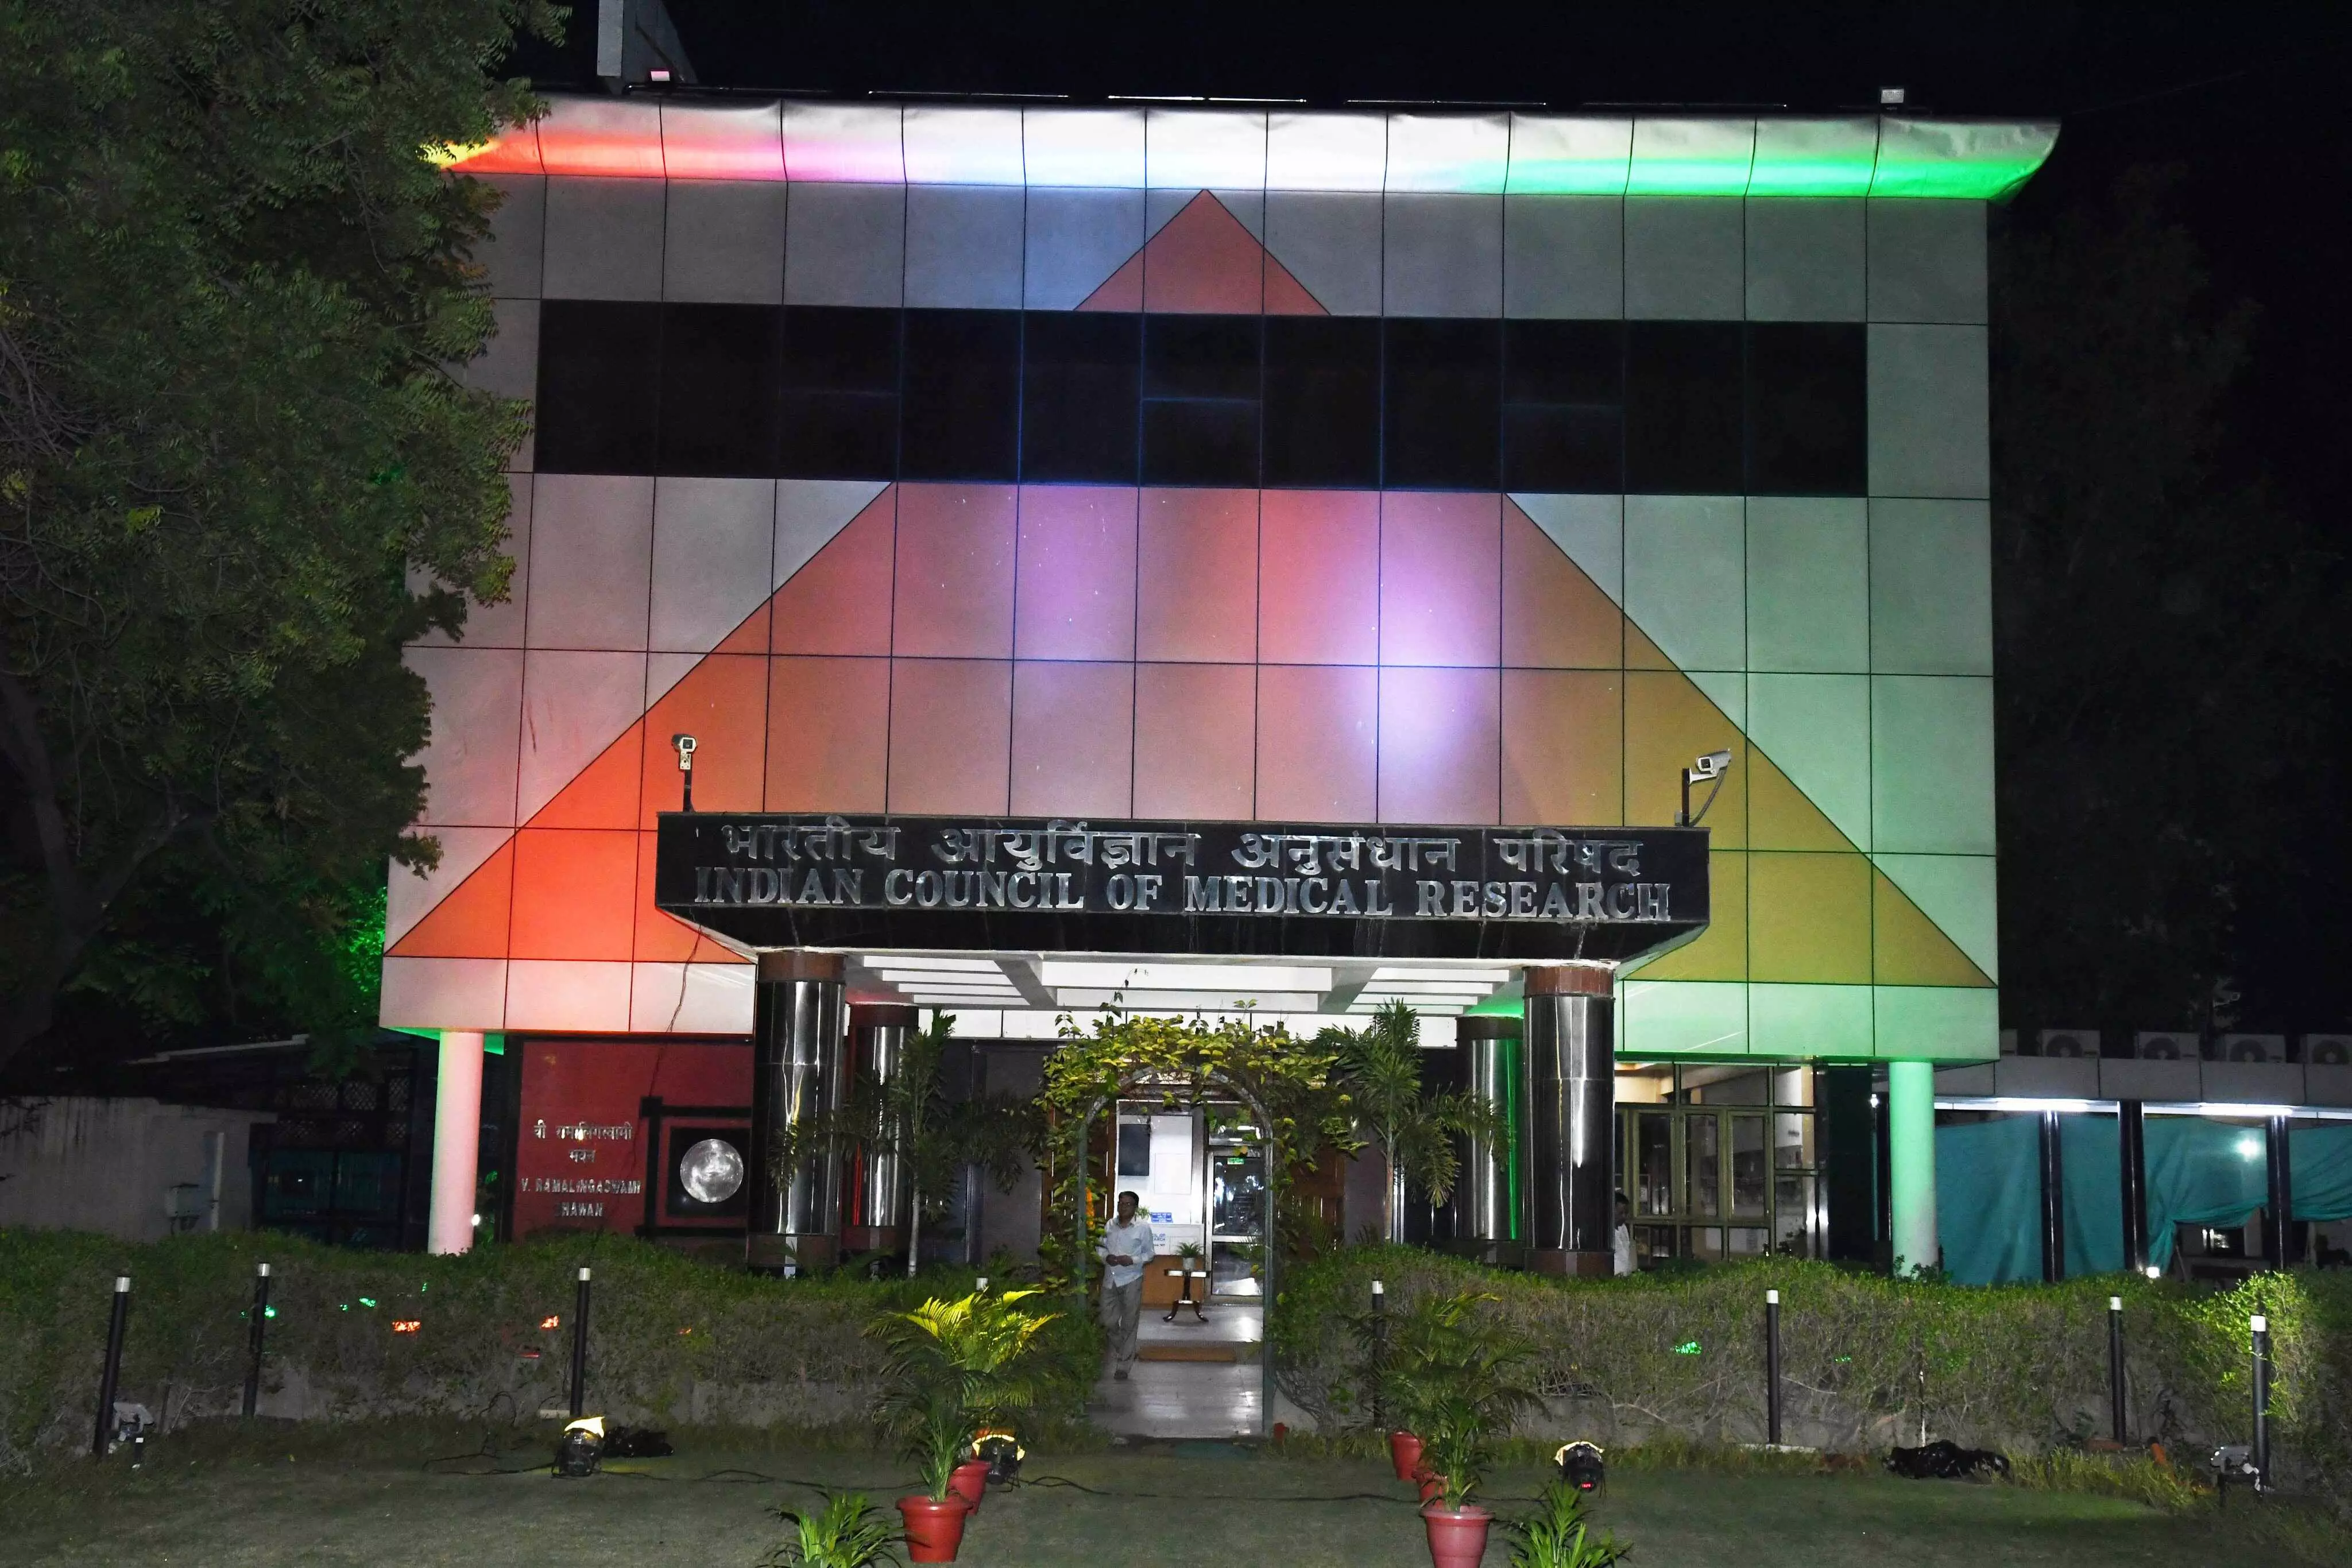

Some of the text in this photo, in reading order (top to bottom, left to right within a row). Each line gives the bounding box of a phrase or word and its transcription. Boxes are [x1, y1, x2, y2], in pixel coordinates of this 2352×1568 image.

[721, 814, 1644, 877] भारतीय आयुर्विज्ञान अनुसंधान परिषद
[694, 866, 1671, 922] INDIAN COUNCIL OF MEDICAL RESEARCH
